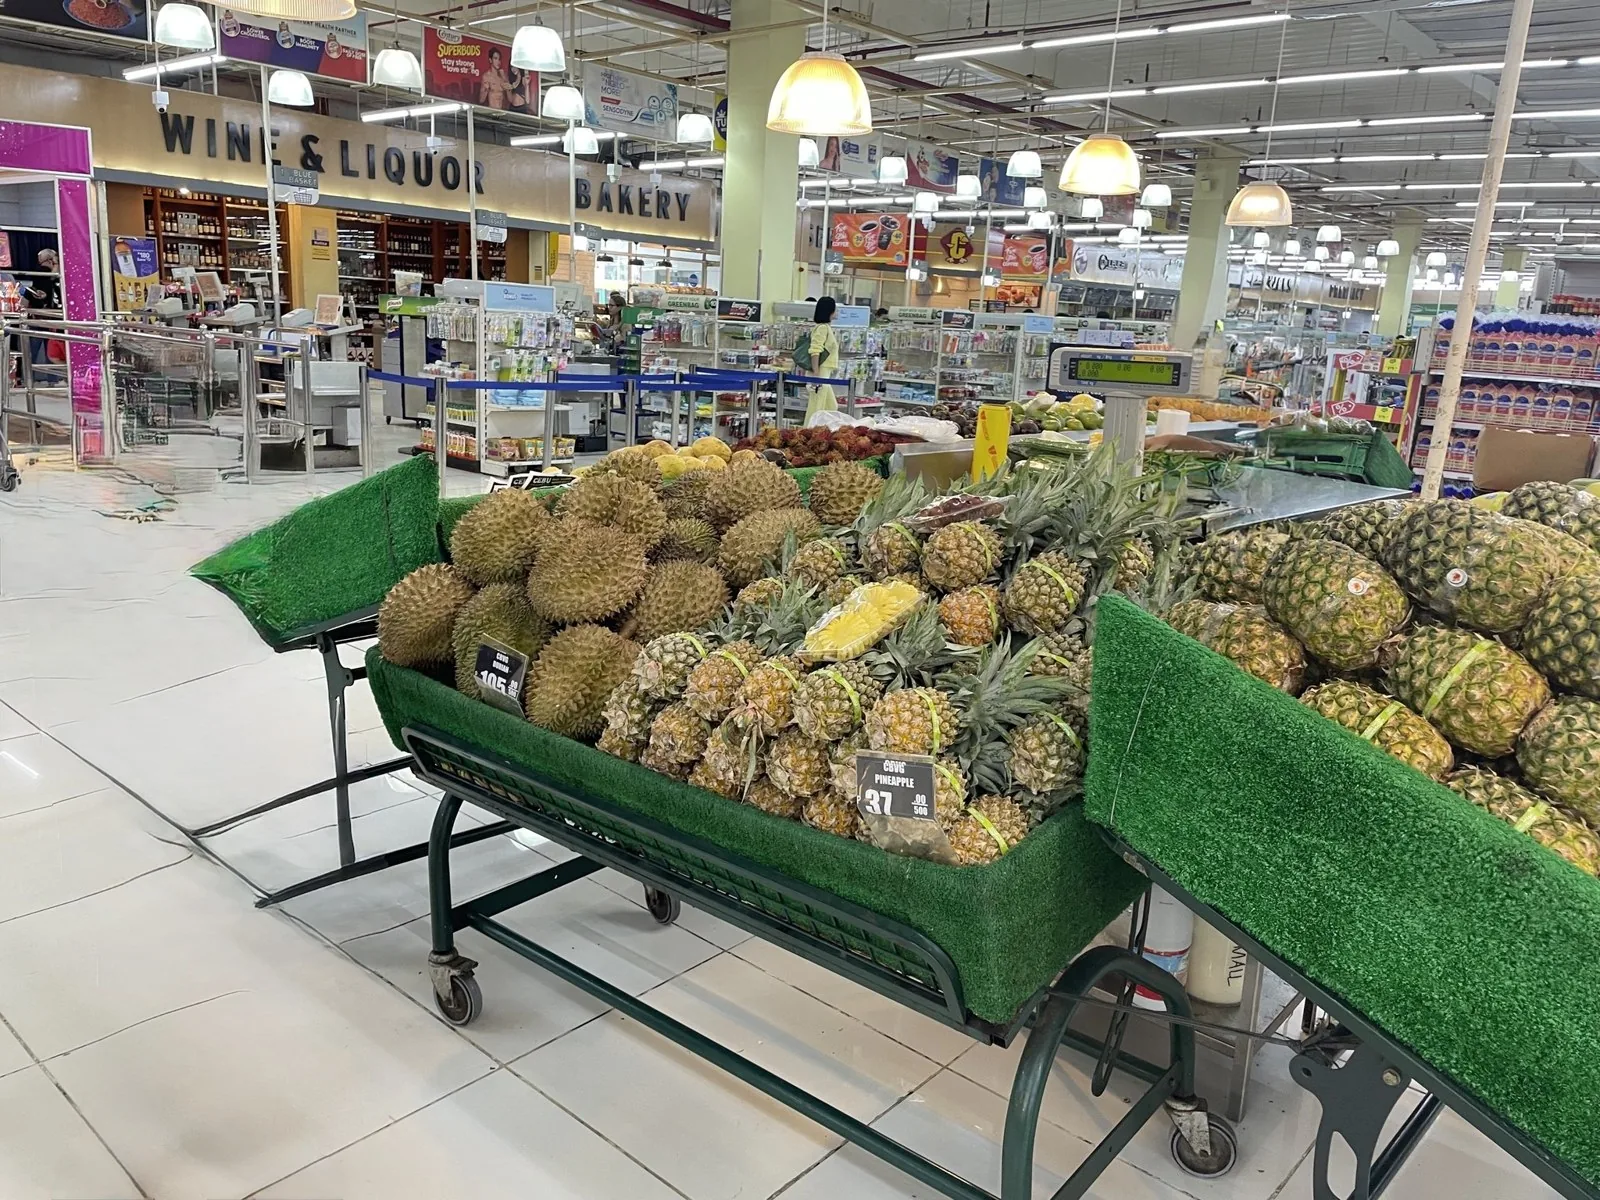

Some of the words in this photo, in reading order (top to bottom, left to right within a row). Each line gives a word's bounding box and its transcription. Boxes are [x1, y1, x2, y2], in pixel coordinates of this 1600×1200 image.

[437, 43, 481, 58] SUPERBODS
[441, 58, 455, 66] stay
[455, 60, 475, 68] strong
[460, 67, 480, 76] strng
[602, 104, 634, 117] SENSODYNE
[160, 112, 282, 166] WINE
[301, 134, 325, 173] &
[340, 139, 485, 195] LIQUOR
[288, 176, 317, 185] BASKET
[293, 170, 312, 179] BLUE
[574, 178, 691, 222] BAKERY
[667, 301, 700, 309] GREENBAG
[480, 670, 507, 696] 105
[874, 773, 915, 789] PINEAPPLE
[864, 788, 893, 816] 37
[913, 805, 928, 816] 500
